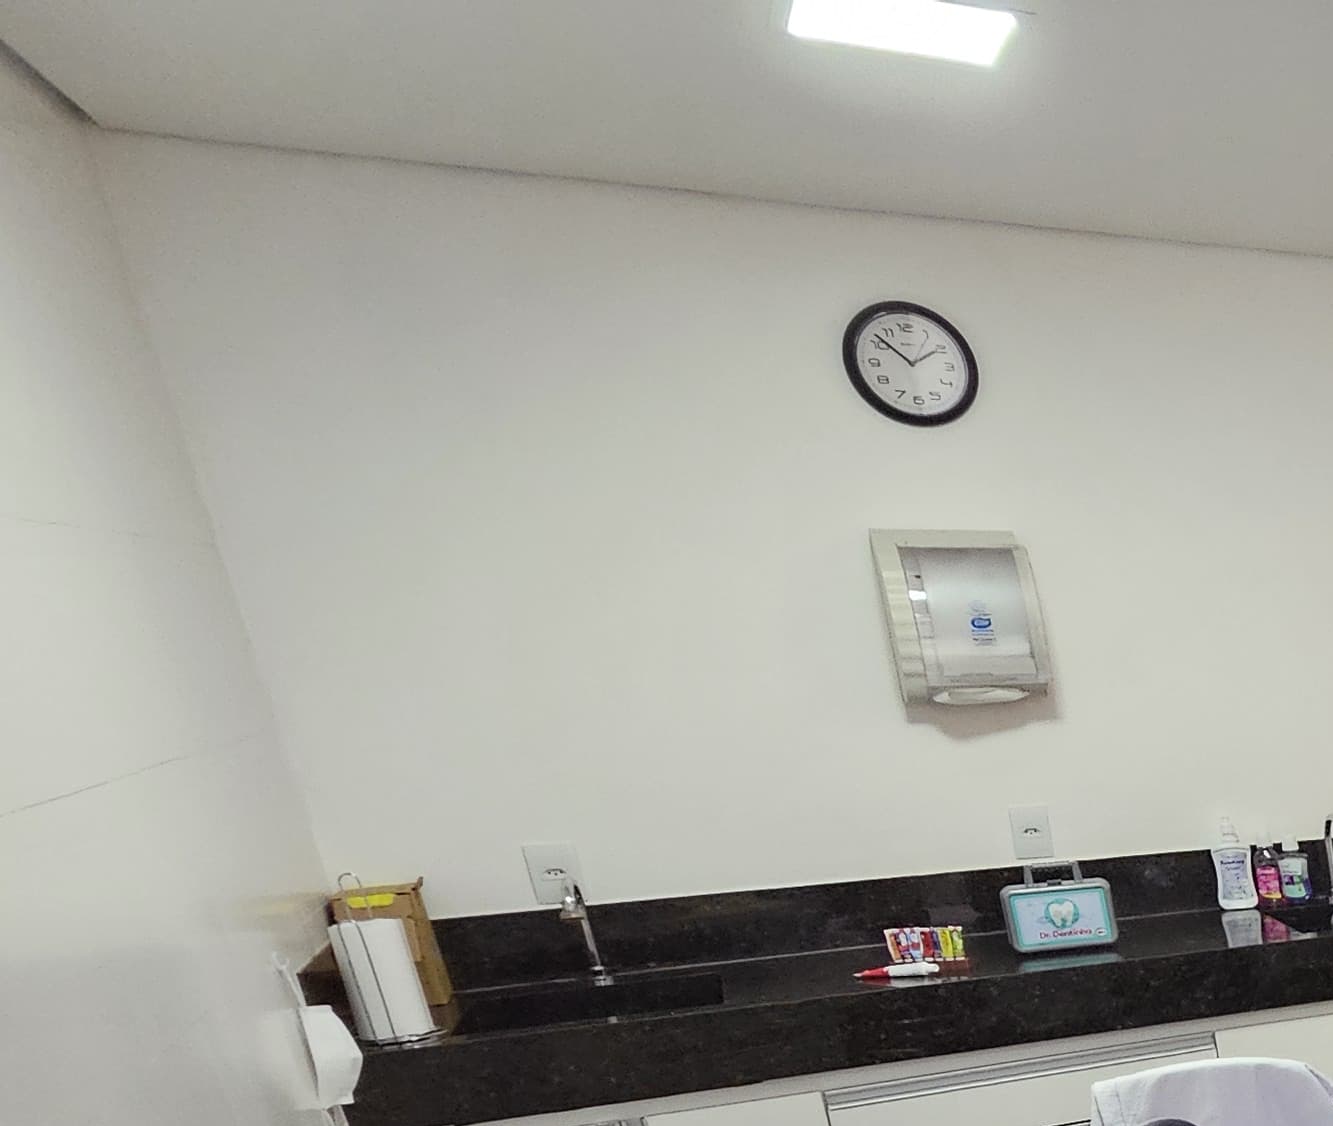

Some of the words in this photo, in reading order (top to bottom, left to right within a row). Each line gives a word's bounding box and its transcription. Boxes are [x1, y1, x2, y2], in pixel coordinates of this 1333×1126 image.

[896, 322, 913, 333] 12
[882, 328, 894, 338] 11
[870, 339, 890, 350] 10
[868, 357, 881, 368] 9
[944, 361, 955, 372] 3
[876, 375, 889, 385] 8
[895, 389, 906, 399] 7
[929, 391, 941, 401] 5
[913, 395, 925, 405] 6
